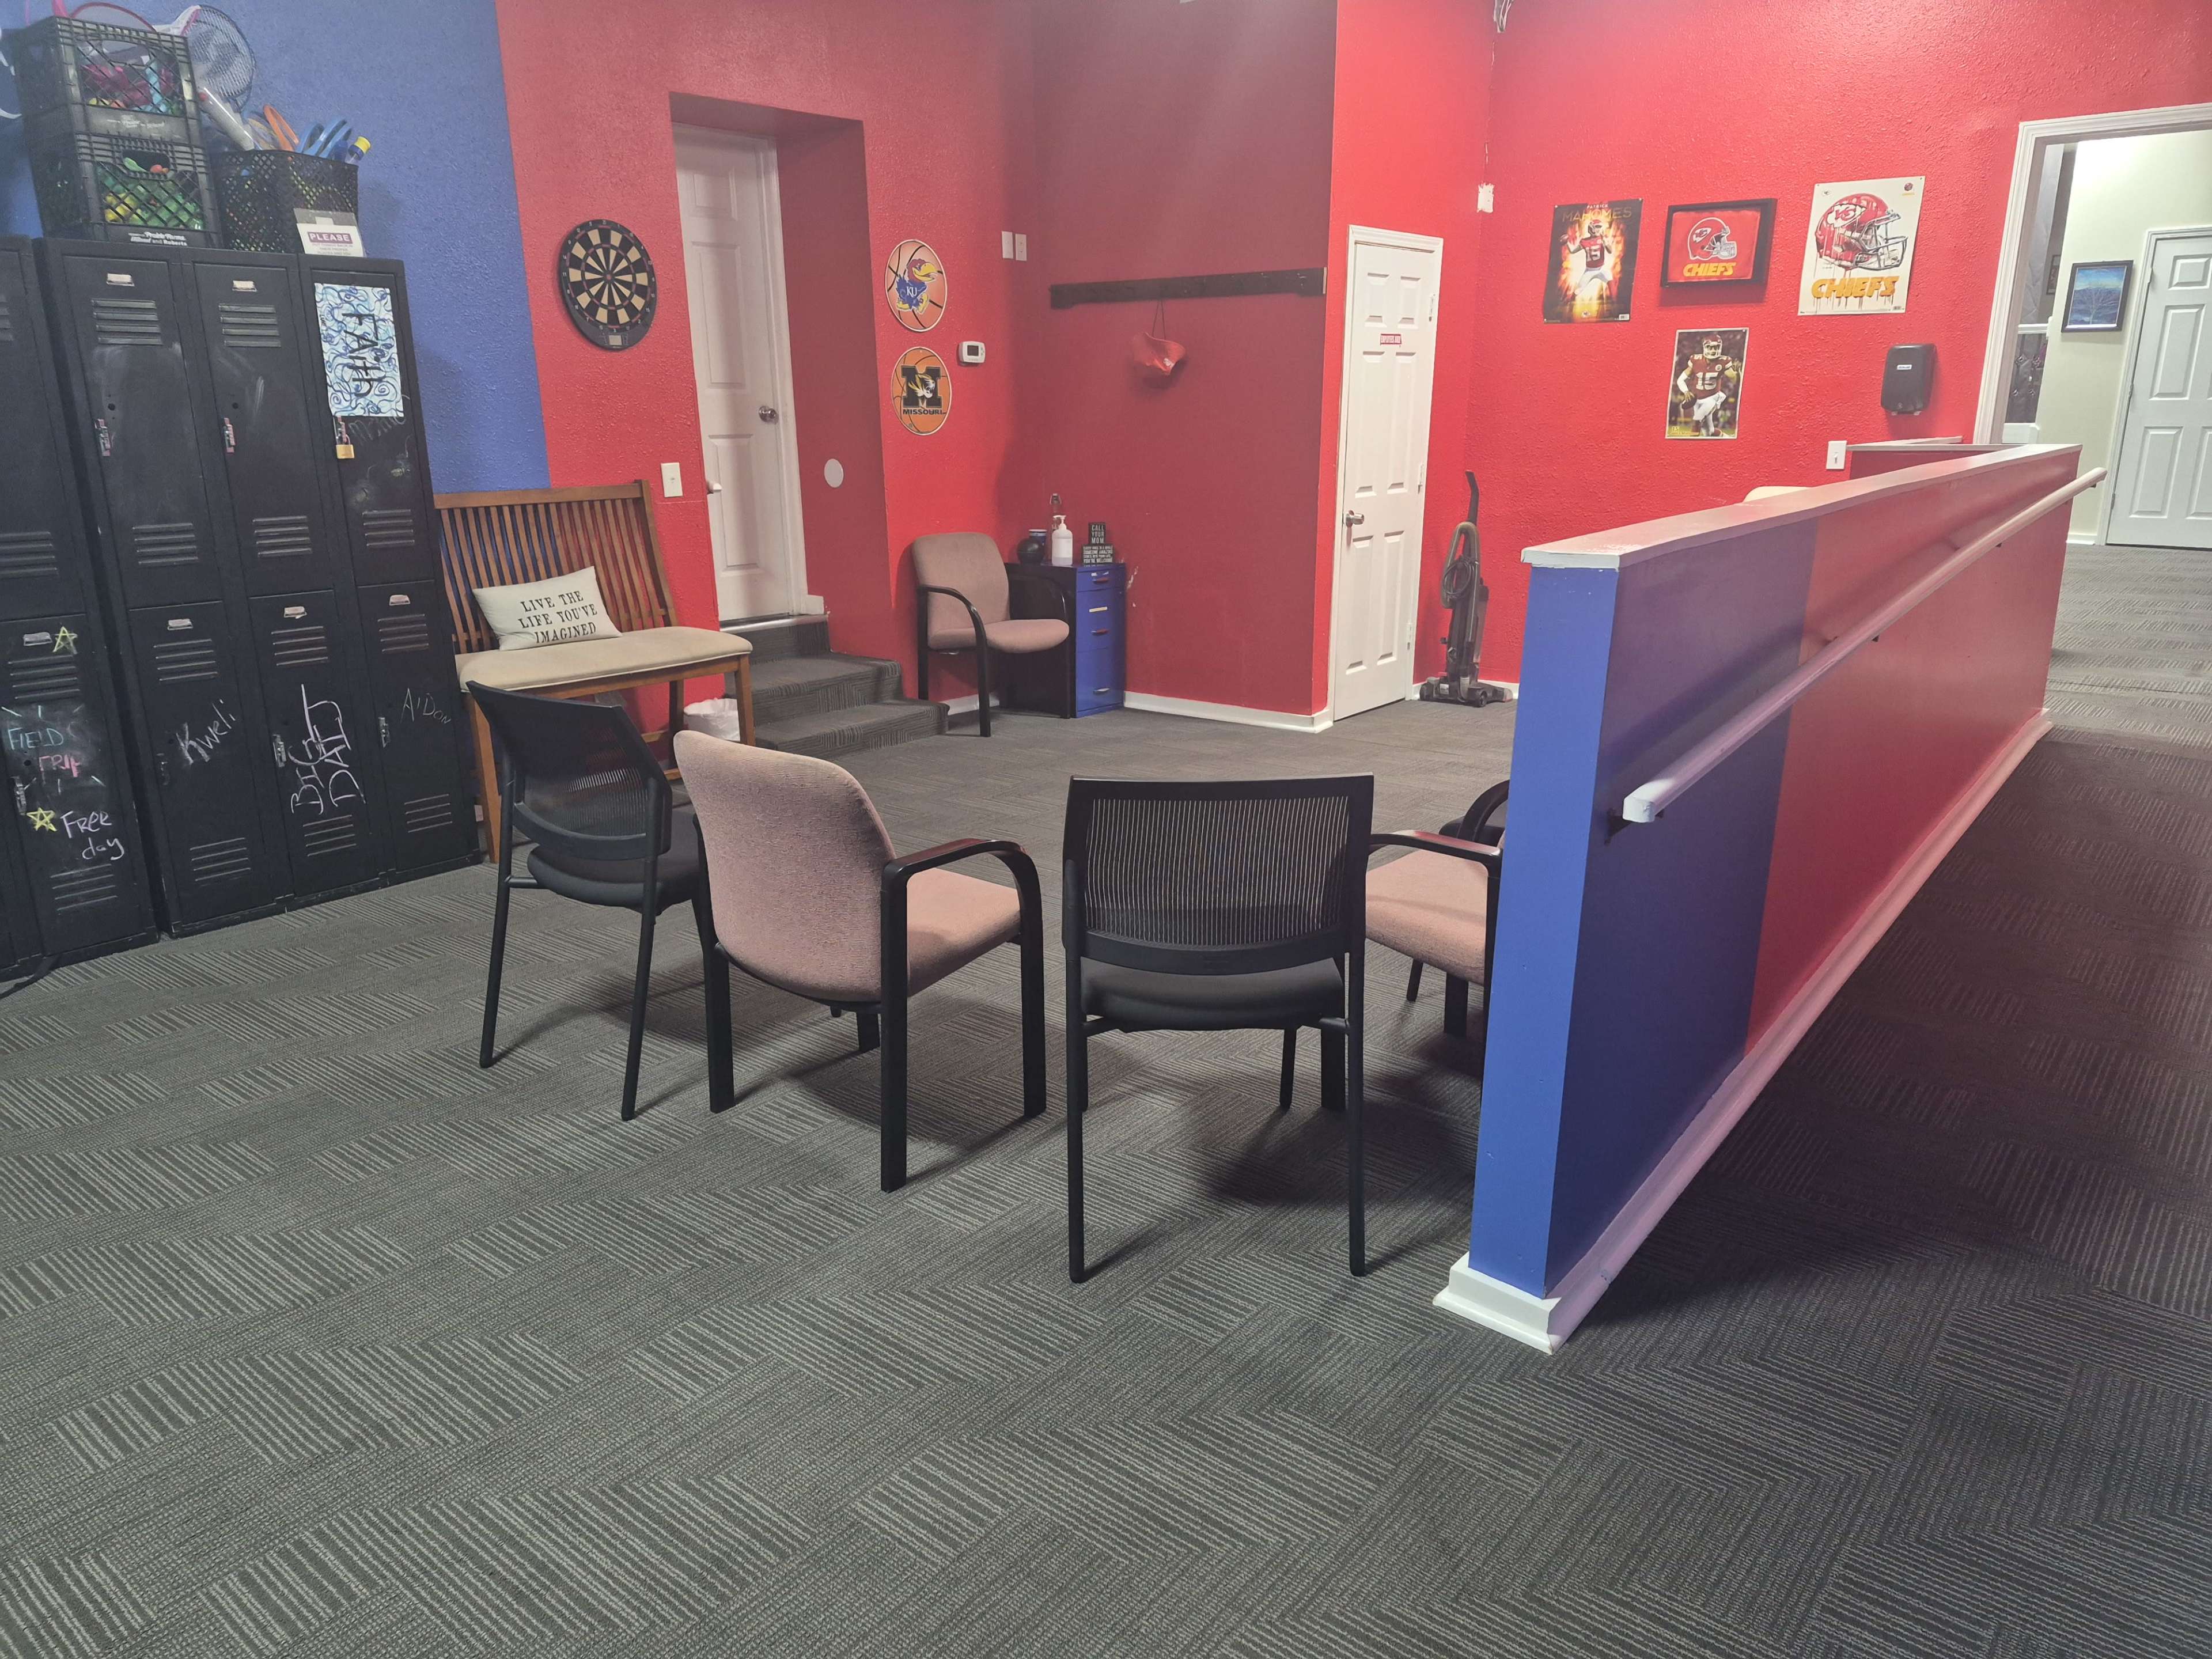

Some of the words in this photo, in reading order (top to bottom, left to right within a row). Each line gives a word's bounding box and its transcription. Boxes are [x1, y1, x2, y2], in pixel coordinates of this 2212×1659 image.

[1562, 207, 1633, 222] MAHOMES
[309, 233, 350, 241] PLEASE
[1585, 245, 1601, 262] 15
[1683, 263, 1736, 277] CHIEFS
[906, 286, 918, 297] KU
[1811, 276, 1900, 298] CHIEFS
[1695, 372, 1719, 391] 15
[520, 597, 555, 612] LIVE
[558, 590, 584, 605] THE
[518, 613, 552, 628] LIFE
[556, 604, 597, 622] YOU'VE
[534, 622, 596, 643] IMAGINED
[7, 728, 64, 750] FIELD
[175, 699, 236, 765] Kweli
[82, 837, 125, 861] day
